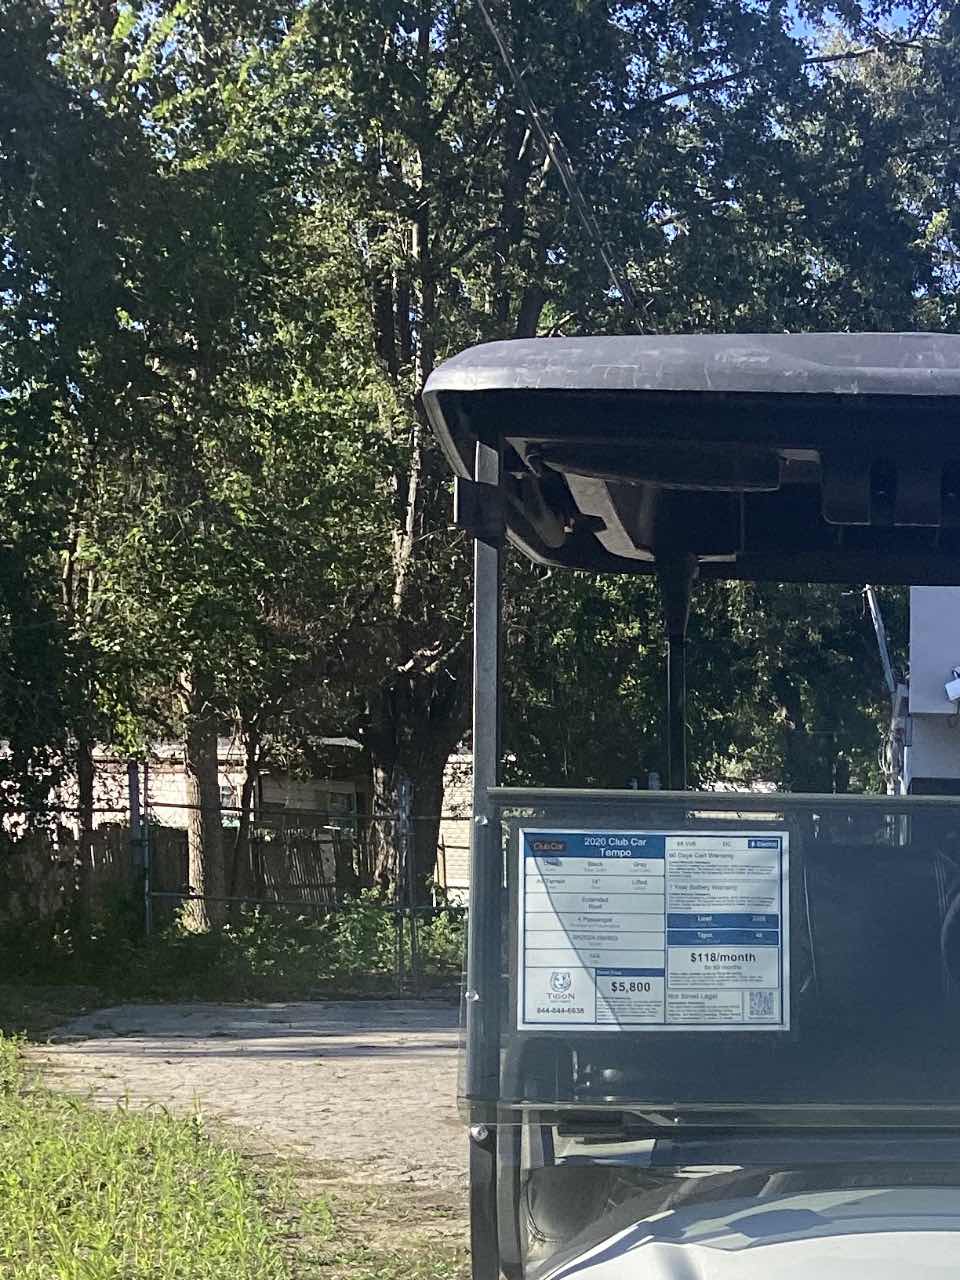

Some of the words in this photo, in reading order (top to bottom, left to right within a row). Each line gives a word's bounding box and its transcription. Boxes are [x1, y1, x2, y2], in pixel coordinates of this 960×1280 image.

[584, 837, 607, 846] 2020
[608, 837, 629, 846] Club
[630, 837, 647, 846] Car
[600, 848, 632, 857] Tempo
[690, 952, 756, 963] $118/month
[611, 981, 651, 993] $5,800
